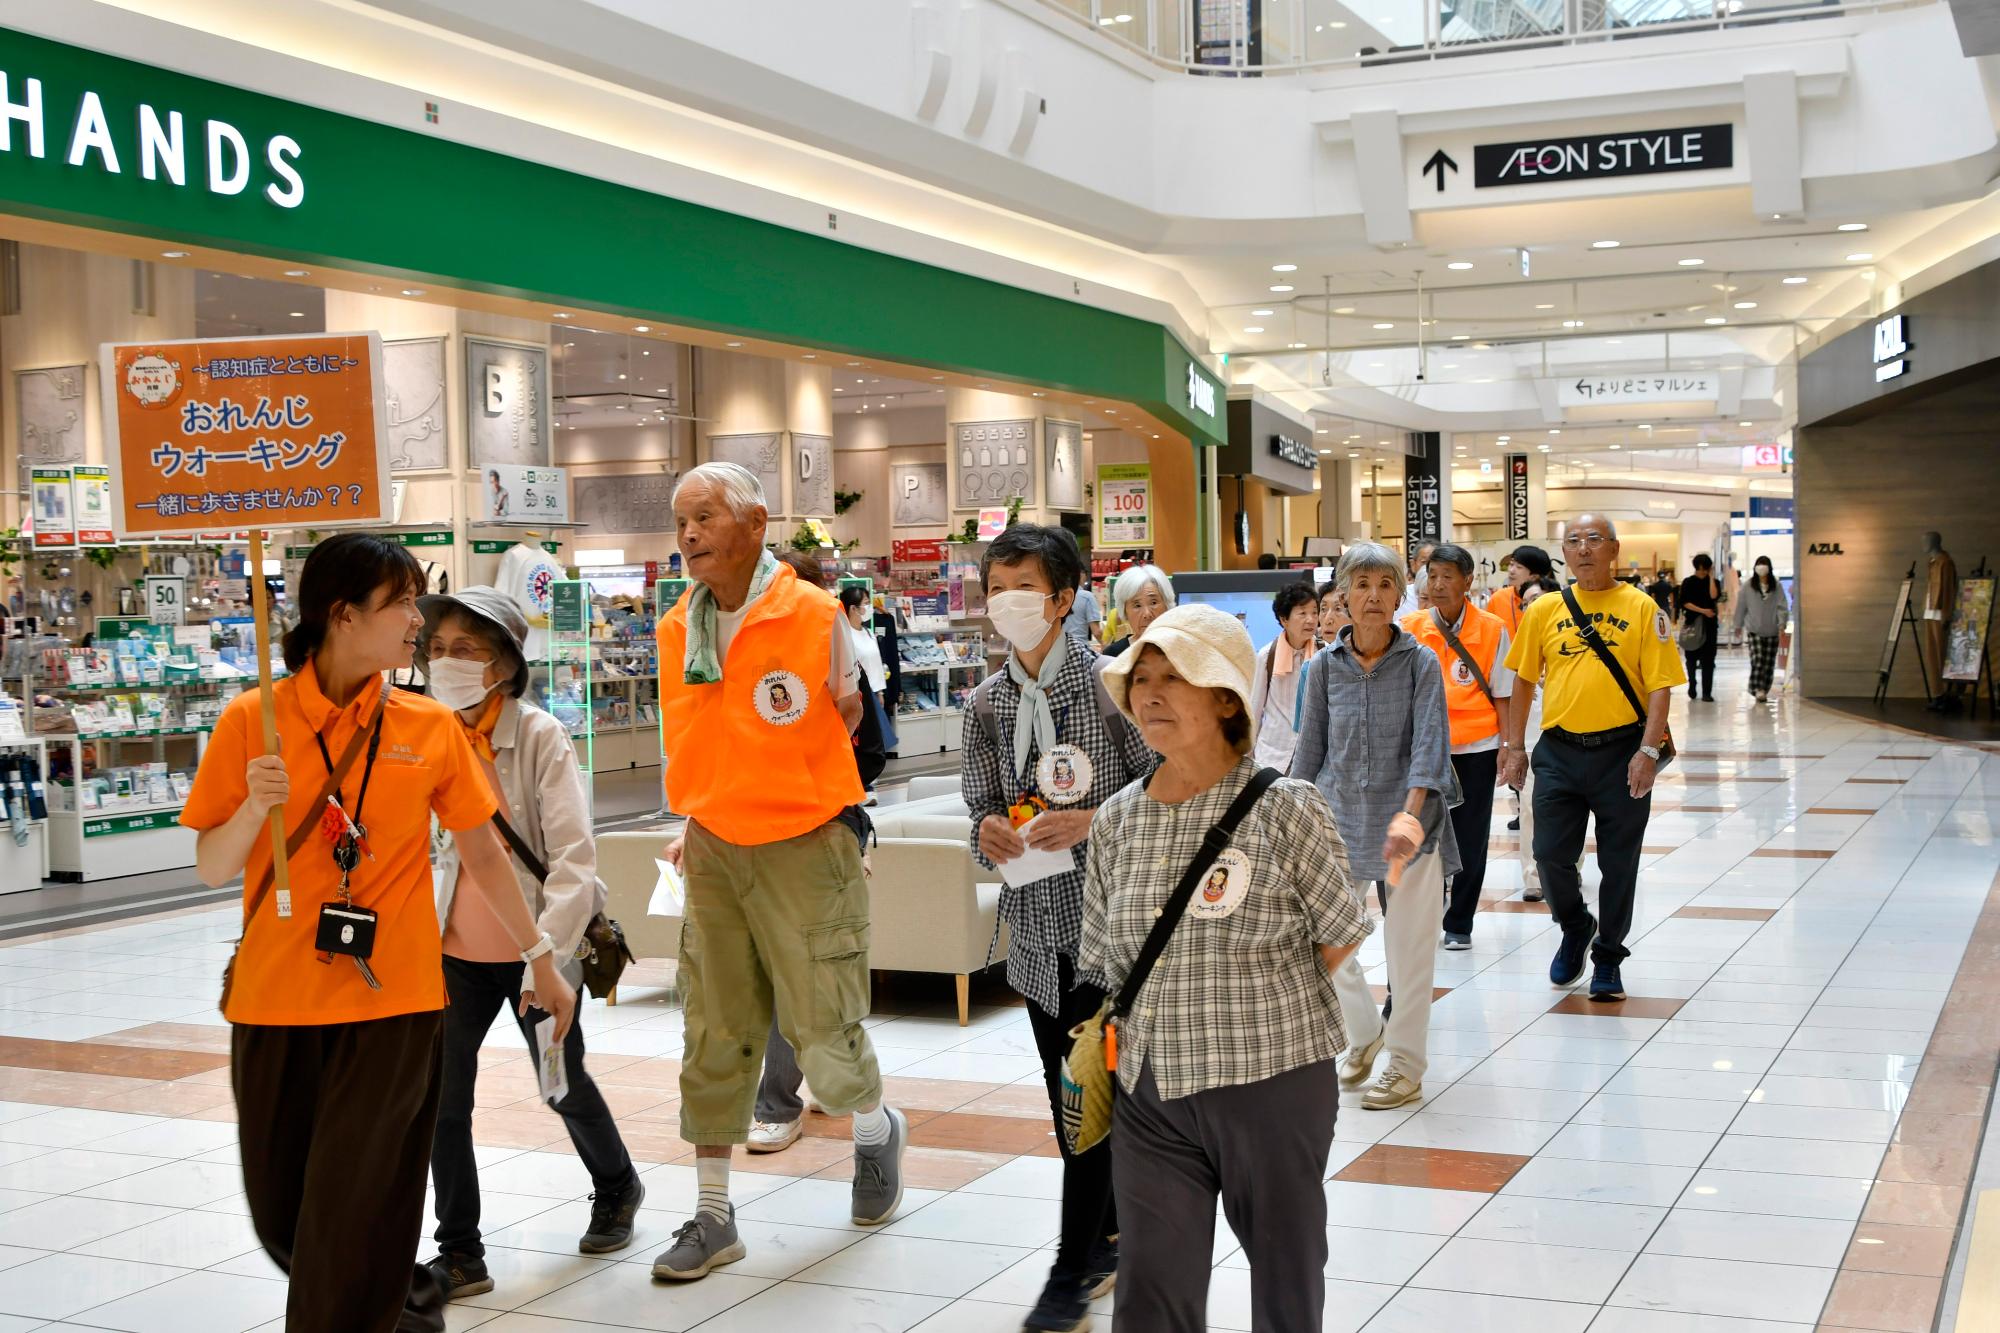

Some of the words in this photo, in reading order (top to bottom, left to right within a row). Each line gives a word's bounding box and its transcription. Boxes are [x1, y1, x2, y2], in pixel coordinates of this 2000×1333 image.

[0, 71, 304, 208] HANDS
[1598, 133, 1703, 171] STYLE
[182, 397, 313, 434] おれんじ
[152, 433, 346, 478] ウォーキング
[801, 448, 813, 479] D
[136, 484, 363, 517] 一緒に歩きませんか？？
[904, 475, 919, 499] P
[1113, 494, 1144, 511] 100
[1407, 490, 1420, 526] East
[1514, 475, 1527, 540] INFORMA
[1808, 543, 1844, 556] AZUL
[156, 585, 175, 605] 50
[1556, 617, 1580, 633] FL
[1607, 613, 1630, 633] ME
[764, 673, 788, 685] おれんじ
[1051, 749, 1076, 757] おれんじ
